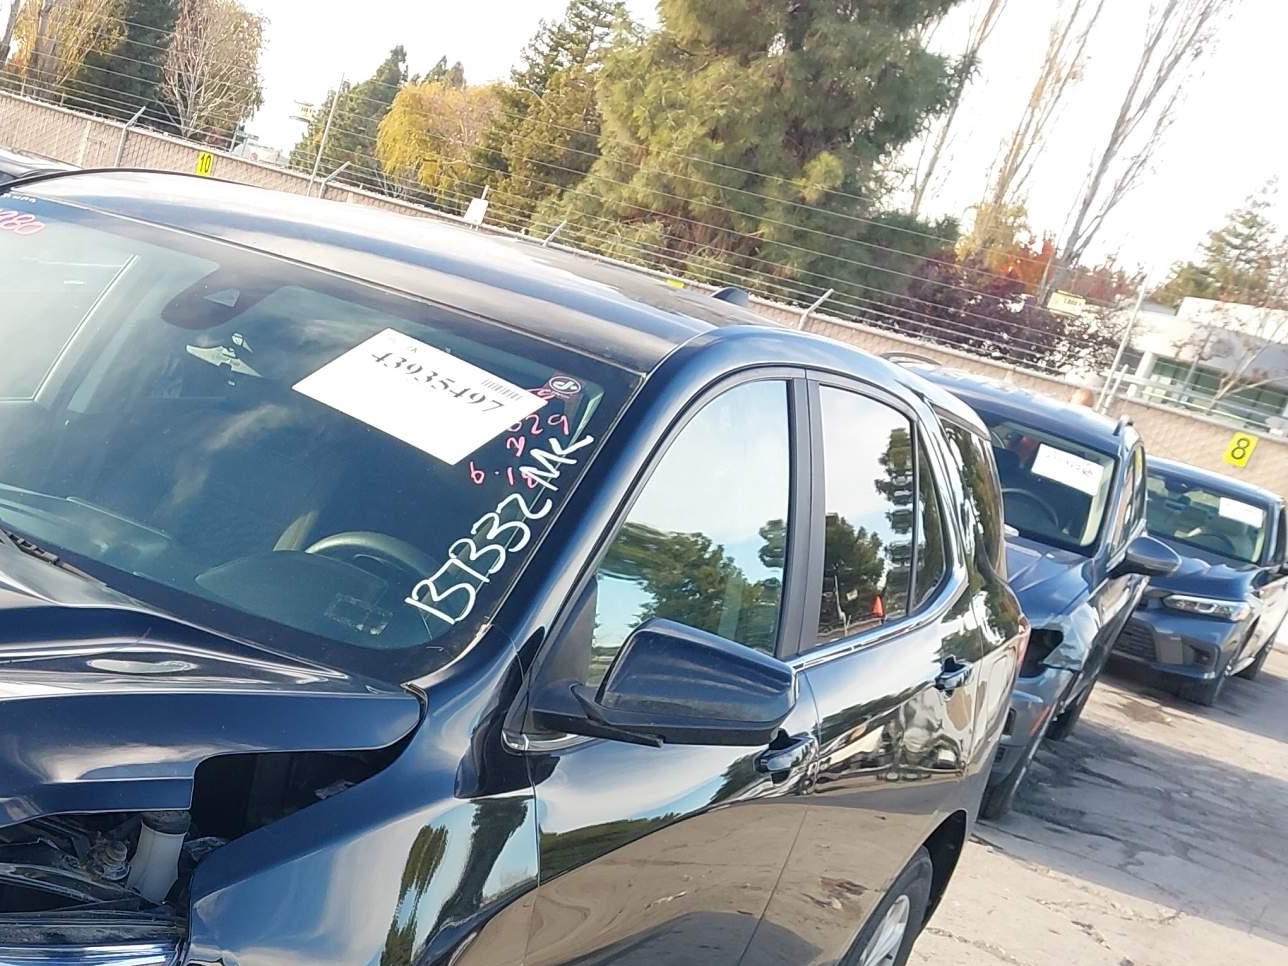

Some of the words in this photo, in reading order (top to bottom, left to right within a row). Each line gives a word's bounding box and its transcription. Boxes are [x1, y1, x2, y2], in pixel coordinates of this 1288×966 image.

[199, 153, 212, 173] 10
[371, 352, 505, 413] 43935497
[1231, 438, 1250, 460] 8
